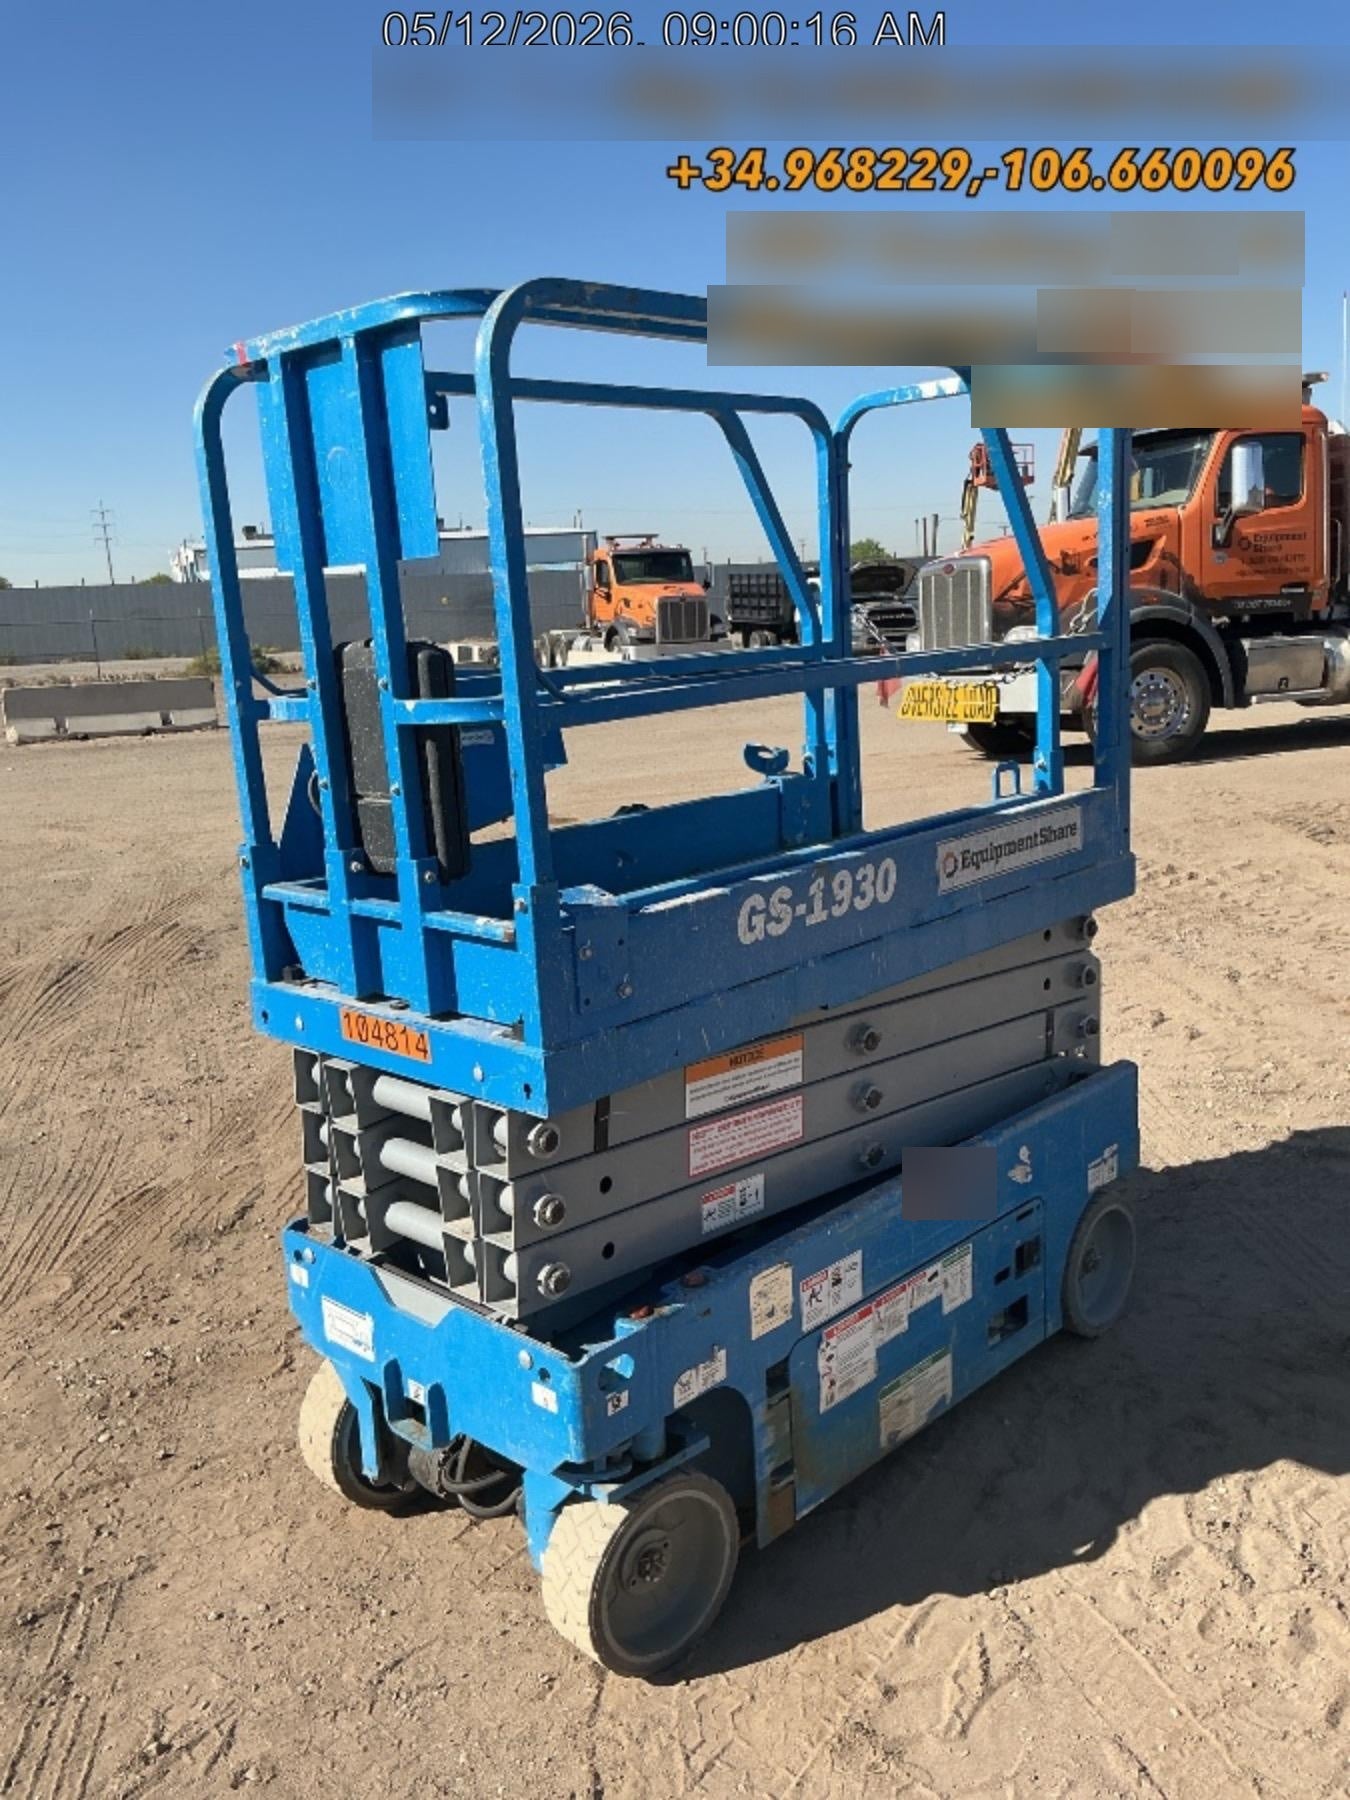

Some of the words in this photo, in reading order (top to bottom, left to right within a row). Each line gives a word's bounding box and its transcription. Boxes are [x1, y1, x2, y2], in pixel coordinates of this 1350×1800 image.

[960, 822, 1078, 872] EquipmentShare
[737, 857, 897, 945] GS-1930
[343, 1011, 429, 1060] 104814
